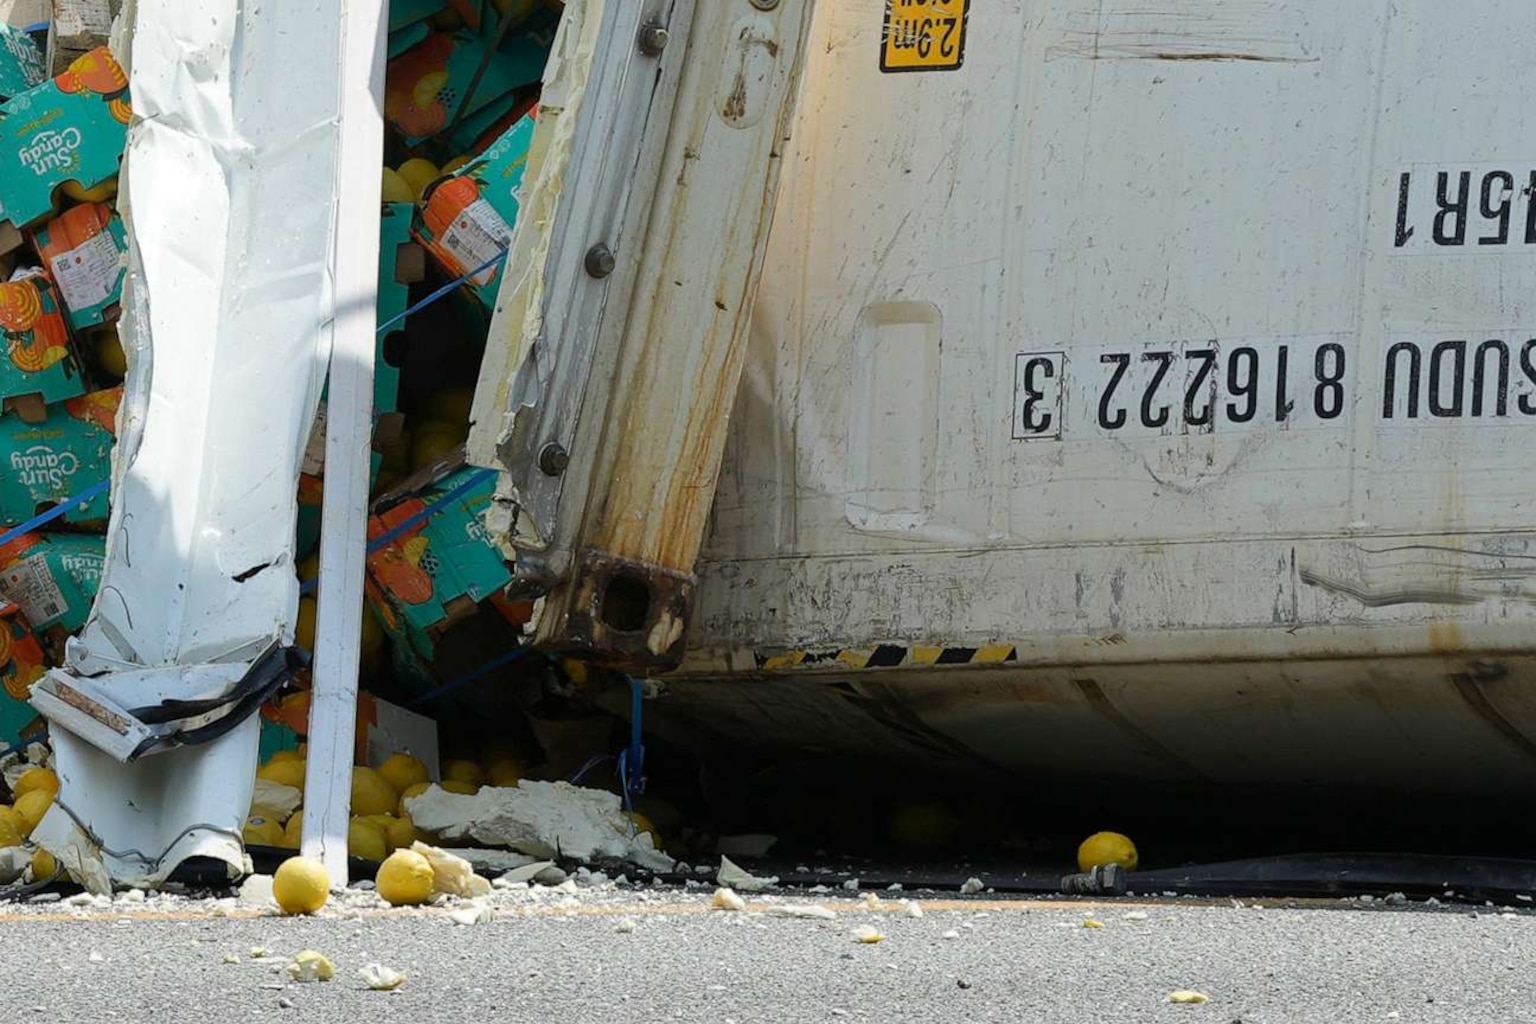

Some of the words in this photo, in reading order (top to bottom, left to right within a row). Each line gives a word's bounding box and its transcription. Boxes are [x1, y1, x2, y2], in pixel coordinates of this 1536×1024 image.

[18, 127, 82, 166] Candy
[31, 147, 72, 176] Sun
[1022, 357, 1055, 433] 3
[1098, 343, 1346, 430] 816222
[10, 451, 78, 475] Candy
[19, 468, 63, 490] Sun
